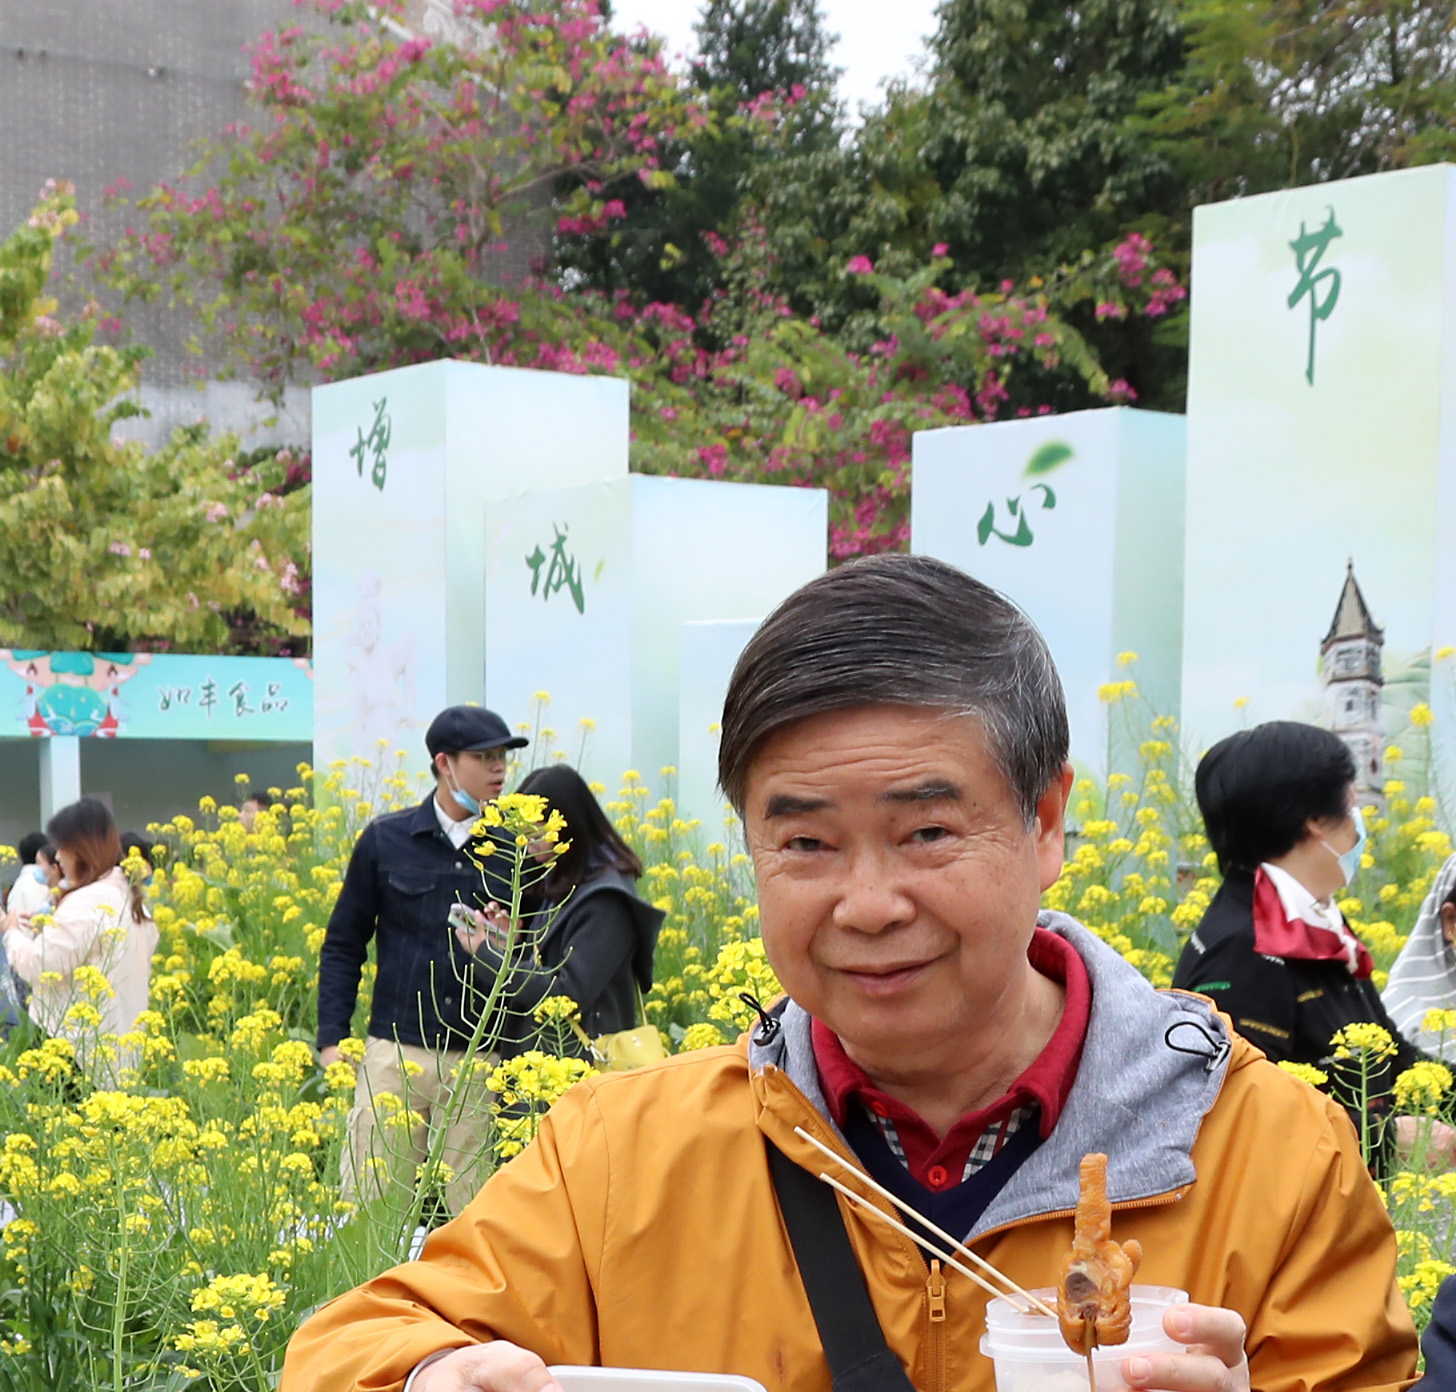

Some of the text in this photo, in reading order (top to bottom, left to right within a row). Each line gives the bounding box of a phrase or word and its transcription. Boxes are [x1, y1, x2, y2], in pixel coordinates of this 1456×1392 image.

[1287, 204, 1343, 387] 节
[349, 396, 391, 491] 增
[977, 482, 1056, 547] 心
[525, 521, 585, 614] 城
